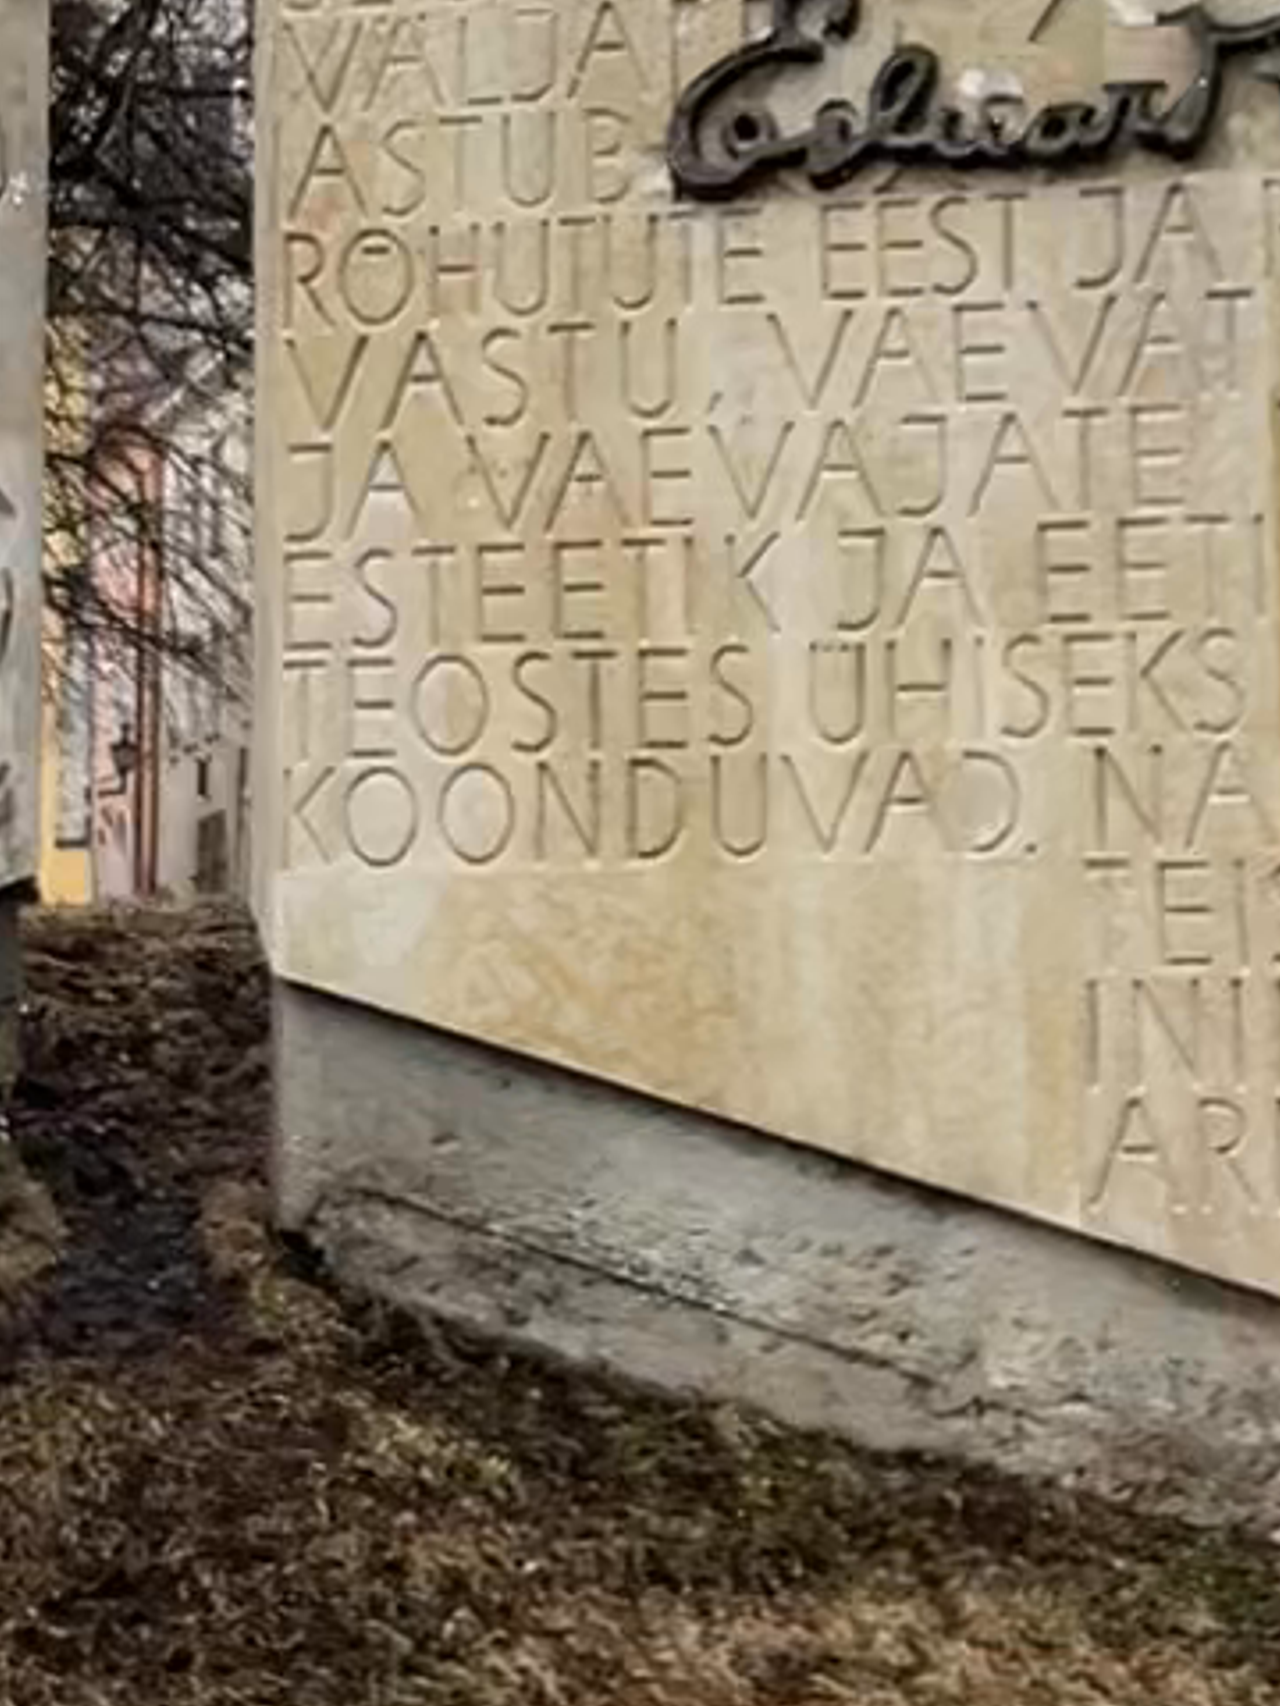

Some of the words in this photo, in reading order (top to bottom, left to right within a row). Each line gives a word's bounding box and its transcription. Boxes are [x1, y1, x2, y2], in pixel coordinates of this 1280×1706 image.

[287, 106, 632, 221] ASTUB
[285, 206, 763, 328] RÕHUTUTE
[821, 191, 1030, 299] EEST
[1075, 183, 1223, 289] JA
[284, 318, 722, 434] VASTU,
[286, 438, 417, 543] JA
[465, 404, 1185, 534] VAEVAJATE
[284, 529, 782, 652] ESTEETIK
[835, 525, 988, 633] JA
[284, 644, 755, 758] TEOSTES
[810, 628, 1247, 744] ÜHISEKS
[284, 748, 1040, 869] KOONDUVAD.
